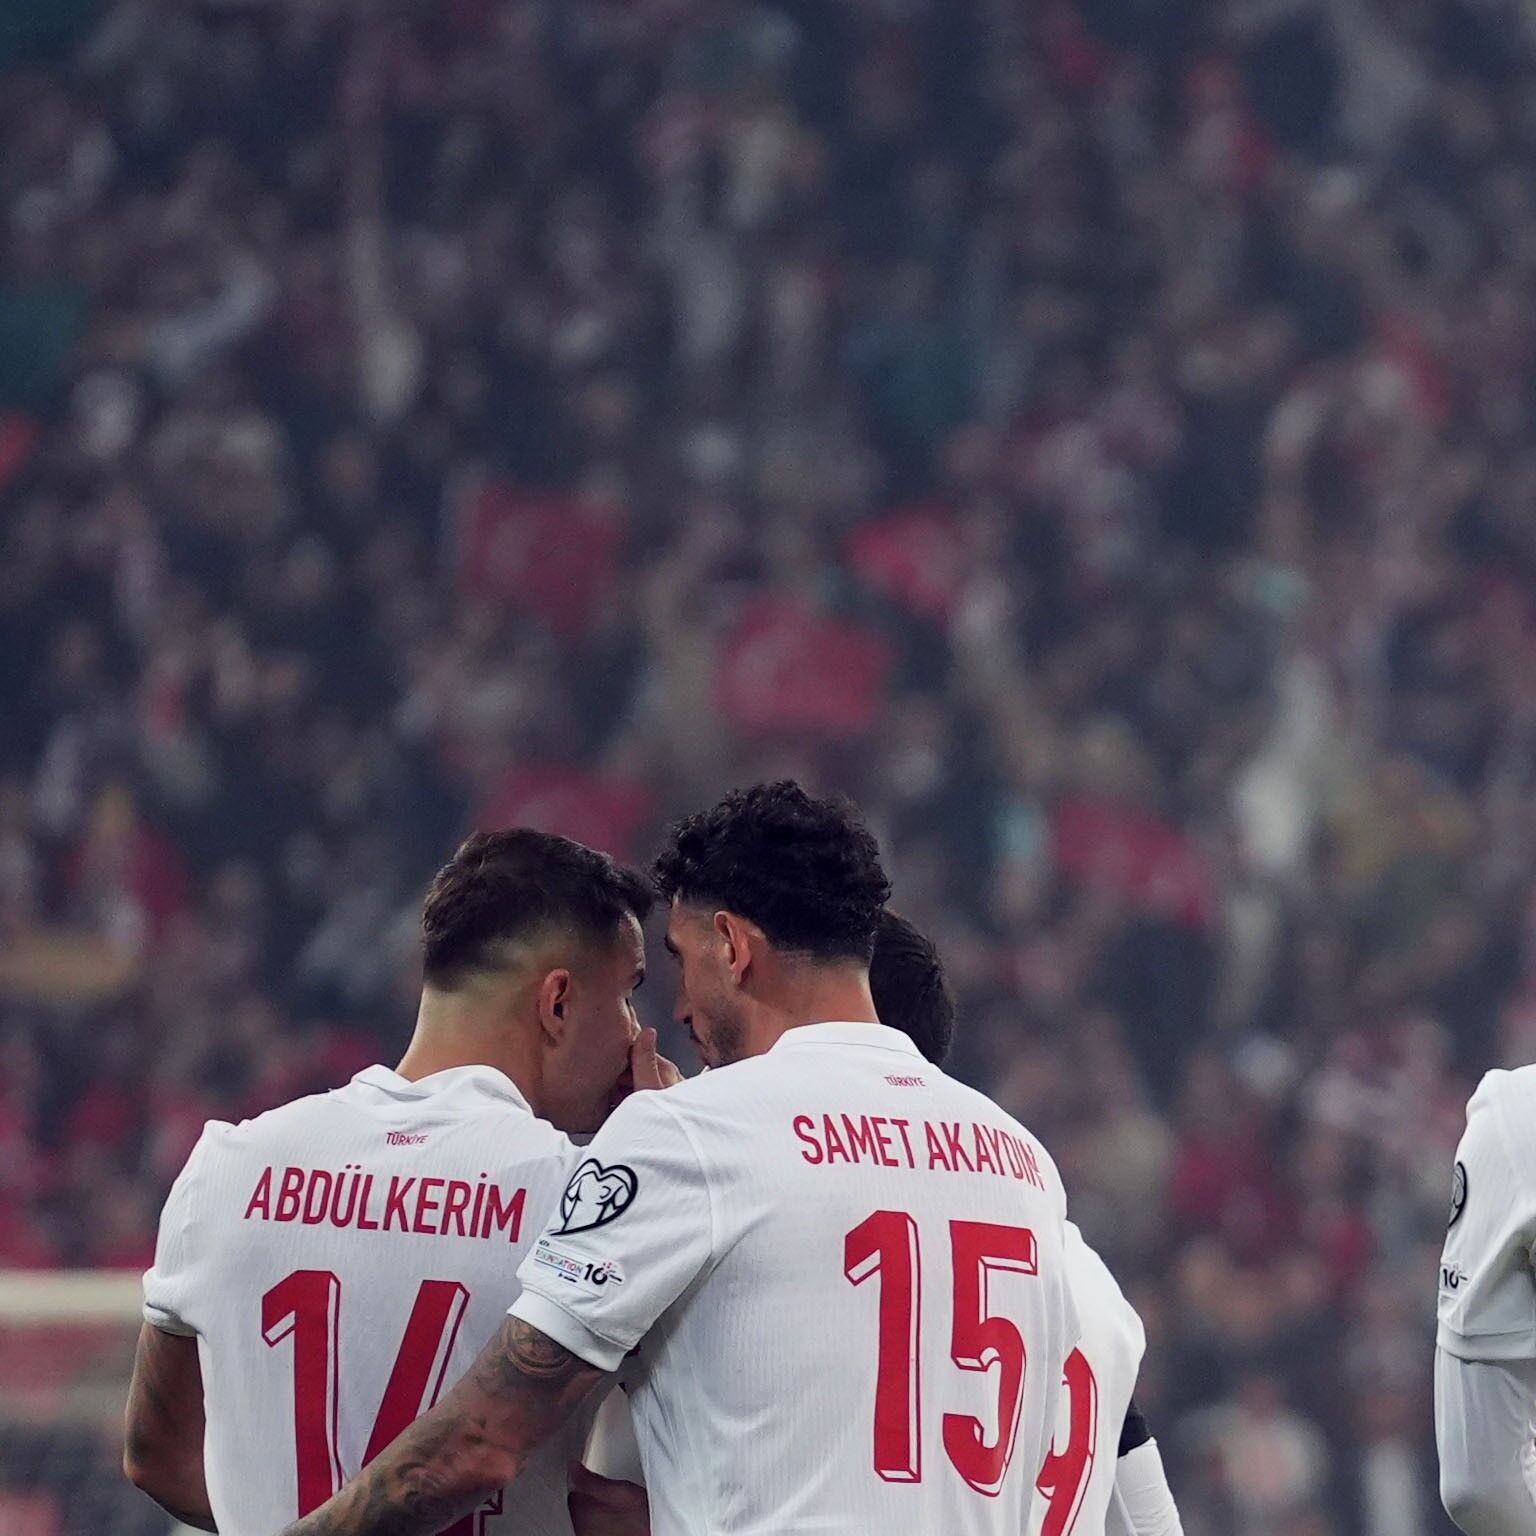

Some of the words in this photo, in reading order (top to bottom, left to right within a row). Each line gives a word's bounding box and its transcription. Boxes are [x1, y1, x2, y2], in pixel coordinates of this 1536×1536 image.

[793, 1113, 911, 1170] SAMET
[927, 1120, 1045, 1192] AKAYDIN
[245, 1165, 528, 1245] ABDÜLKERİM
[844, 1210, 1038, 1499] 15
